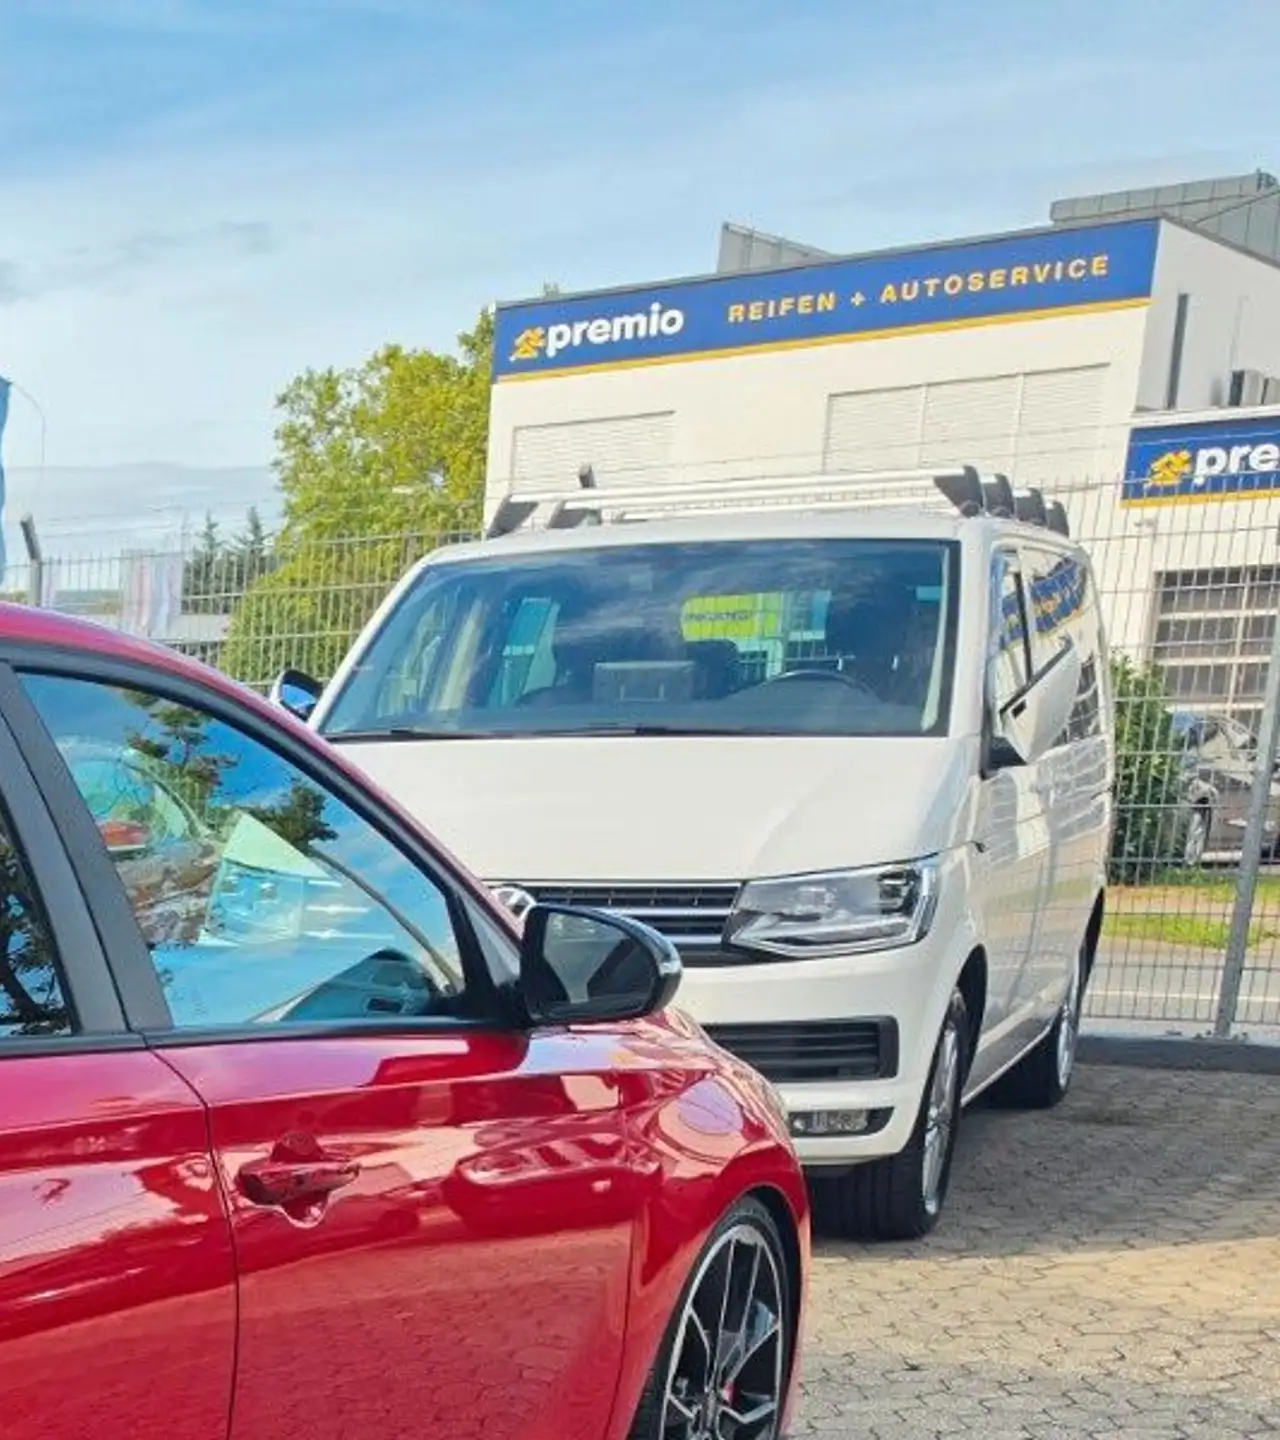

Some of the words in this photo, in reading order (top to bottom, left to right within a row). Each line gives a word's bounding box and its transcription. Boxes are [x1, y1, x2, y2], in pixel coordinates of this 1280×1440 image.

[728, 292, 836, 323] REIFEN
[851, 291, 865, 307] +
[880, 254, 1109, 304] AUTOSERVICE
[547, 302, 685, 358] premio
